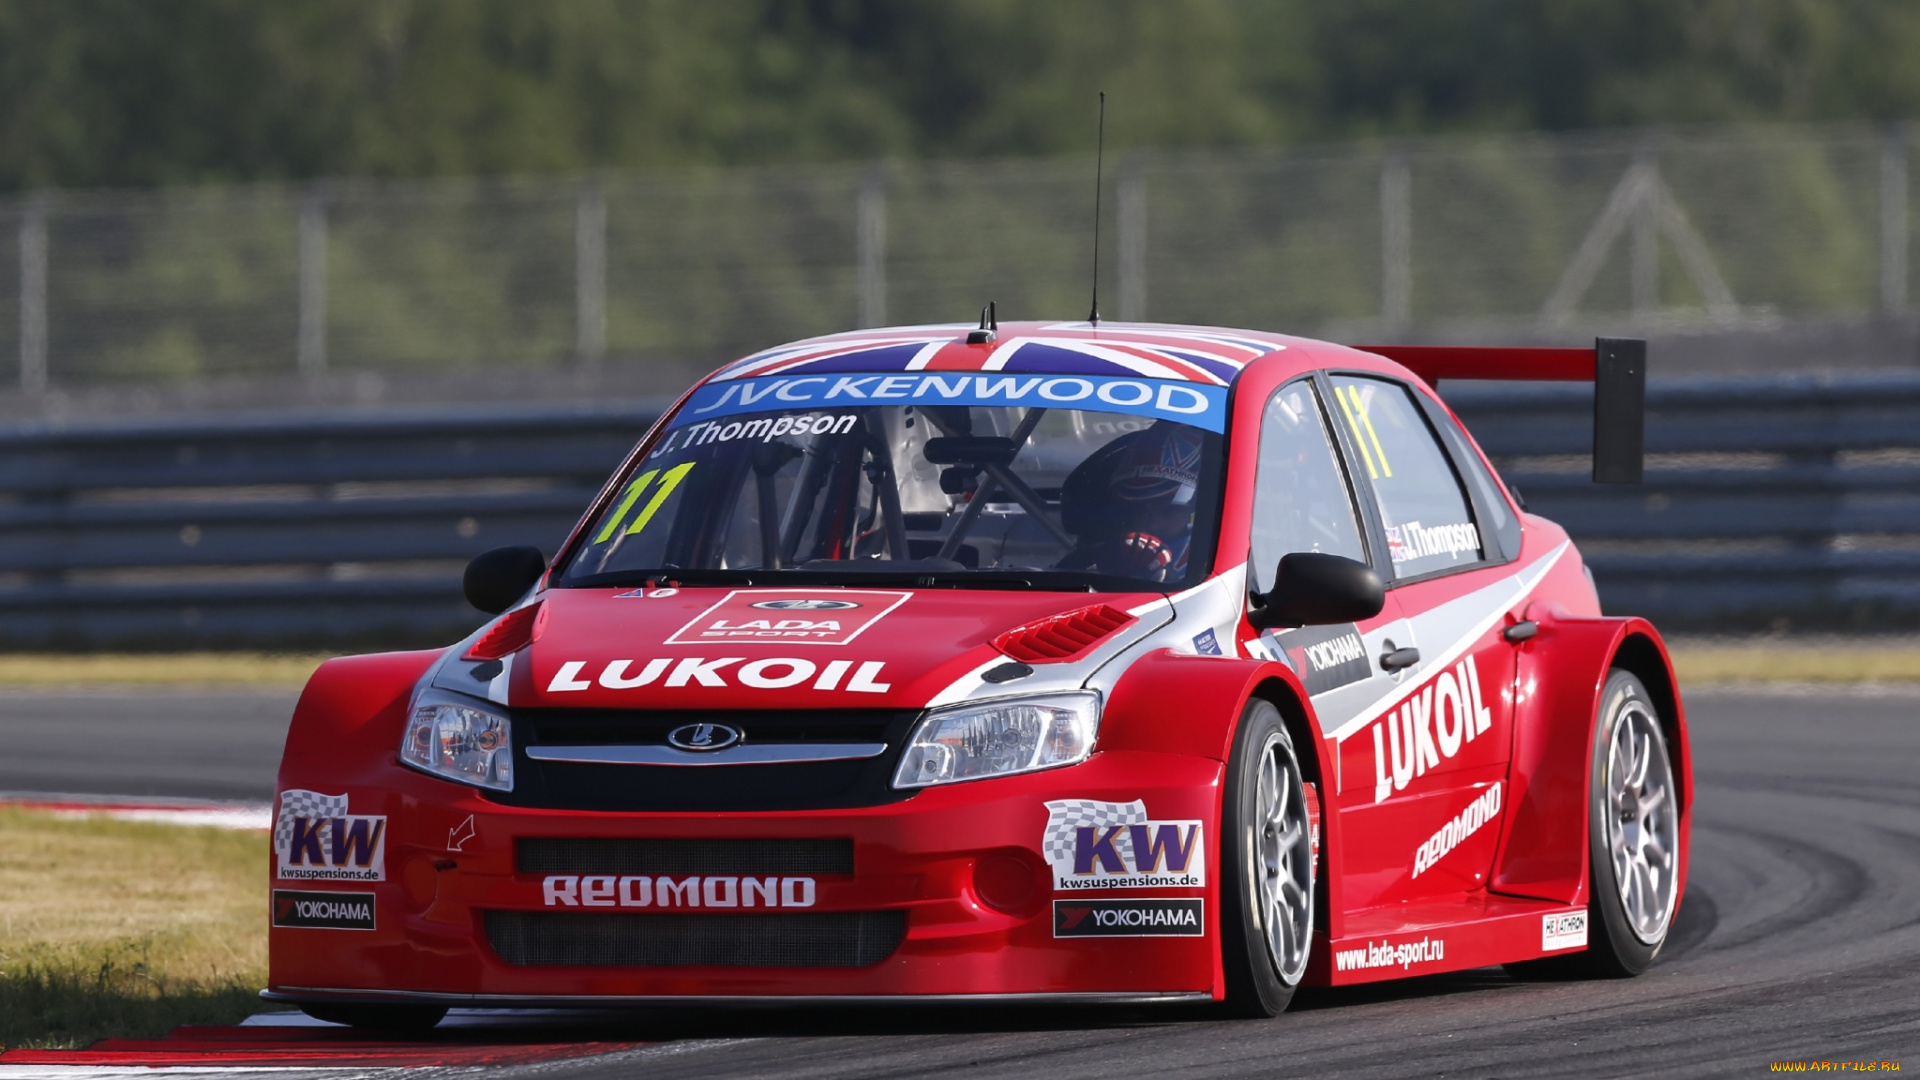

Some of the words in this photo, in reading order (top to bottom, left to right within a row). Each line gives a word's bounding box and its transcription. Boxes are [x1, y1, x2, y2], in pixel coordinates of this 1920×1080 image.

[694, 376, 1208, 414] JVCKENWOOD
[681, 414, 857, 449] Thompson
[1334, 384, 1392, 479] 11
[593, 462, 696, 545] 11
[709, 619, 841, 630] LADA
[1304, 633, 1365, 672] YOKOHAMA
[547, 657, 891, 693] LUKOIL
[1372, 653, 1491, 804] LUKOIL
[289, 817, 385, 868] KW
[1412, 781, 1501, 879] REDMOND
[1073, 824, 1202, 876] KW
[281, 867, 379, 880] kwsuspensions.de
[543, 876, 816, 907] REDMOND
[1060, 874, 1199, 888] kwsuspensions.de
[295, 901, 371, 920] YOKOHAMA
[1093, 909, 1197, 926] YOKOHAMA
[1336, 936, 1444, 970] www.lada-sport.ru
